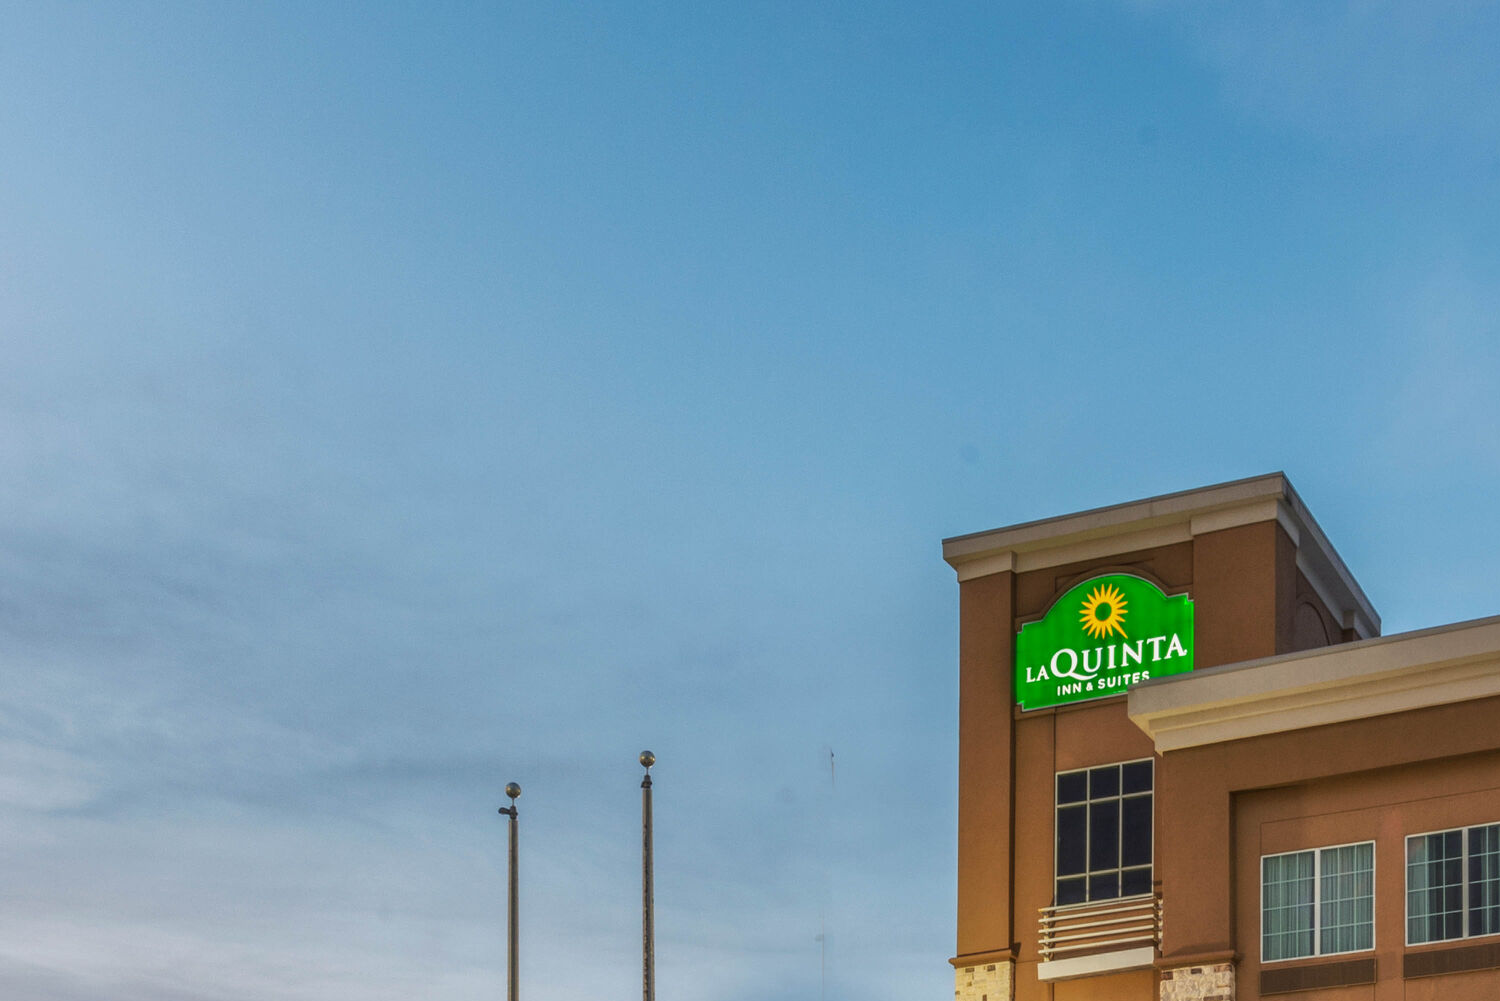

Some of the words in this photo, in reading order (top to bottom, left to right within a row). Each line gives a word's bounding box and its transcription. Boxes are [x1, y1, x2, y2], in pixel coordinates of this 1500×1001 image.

[1026, 665, 1050, 683] LA
[1050, 633, 1188, 681] QUINTA
[1057, 680, 1082, 696] INN
[1086, 682, 1094, 691] &
[1098, 671, 1150, 690] SUITES
